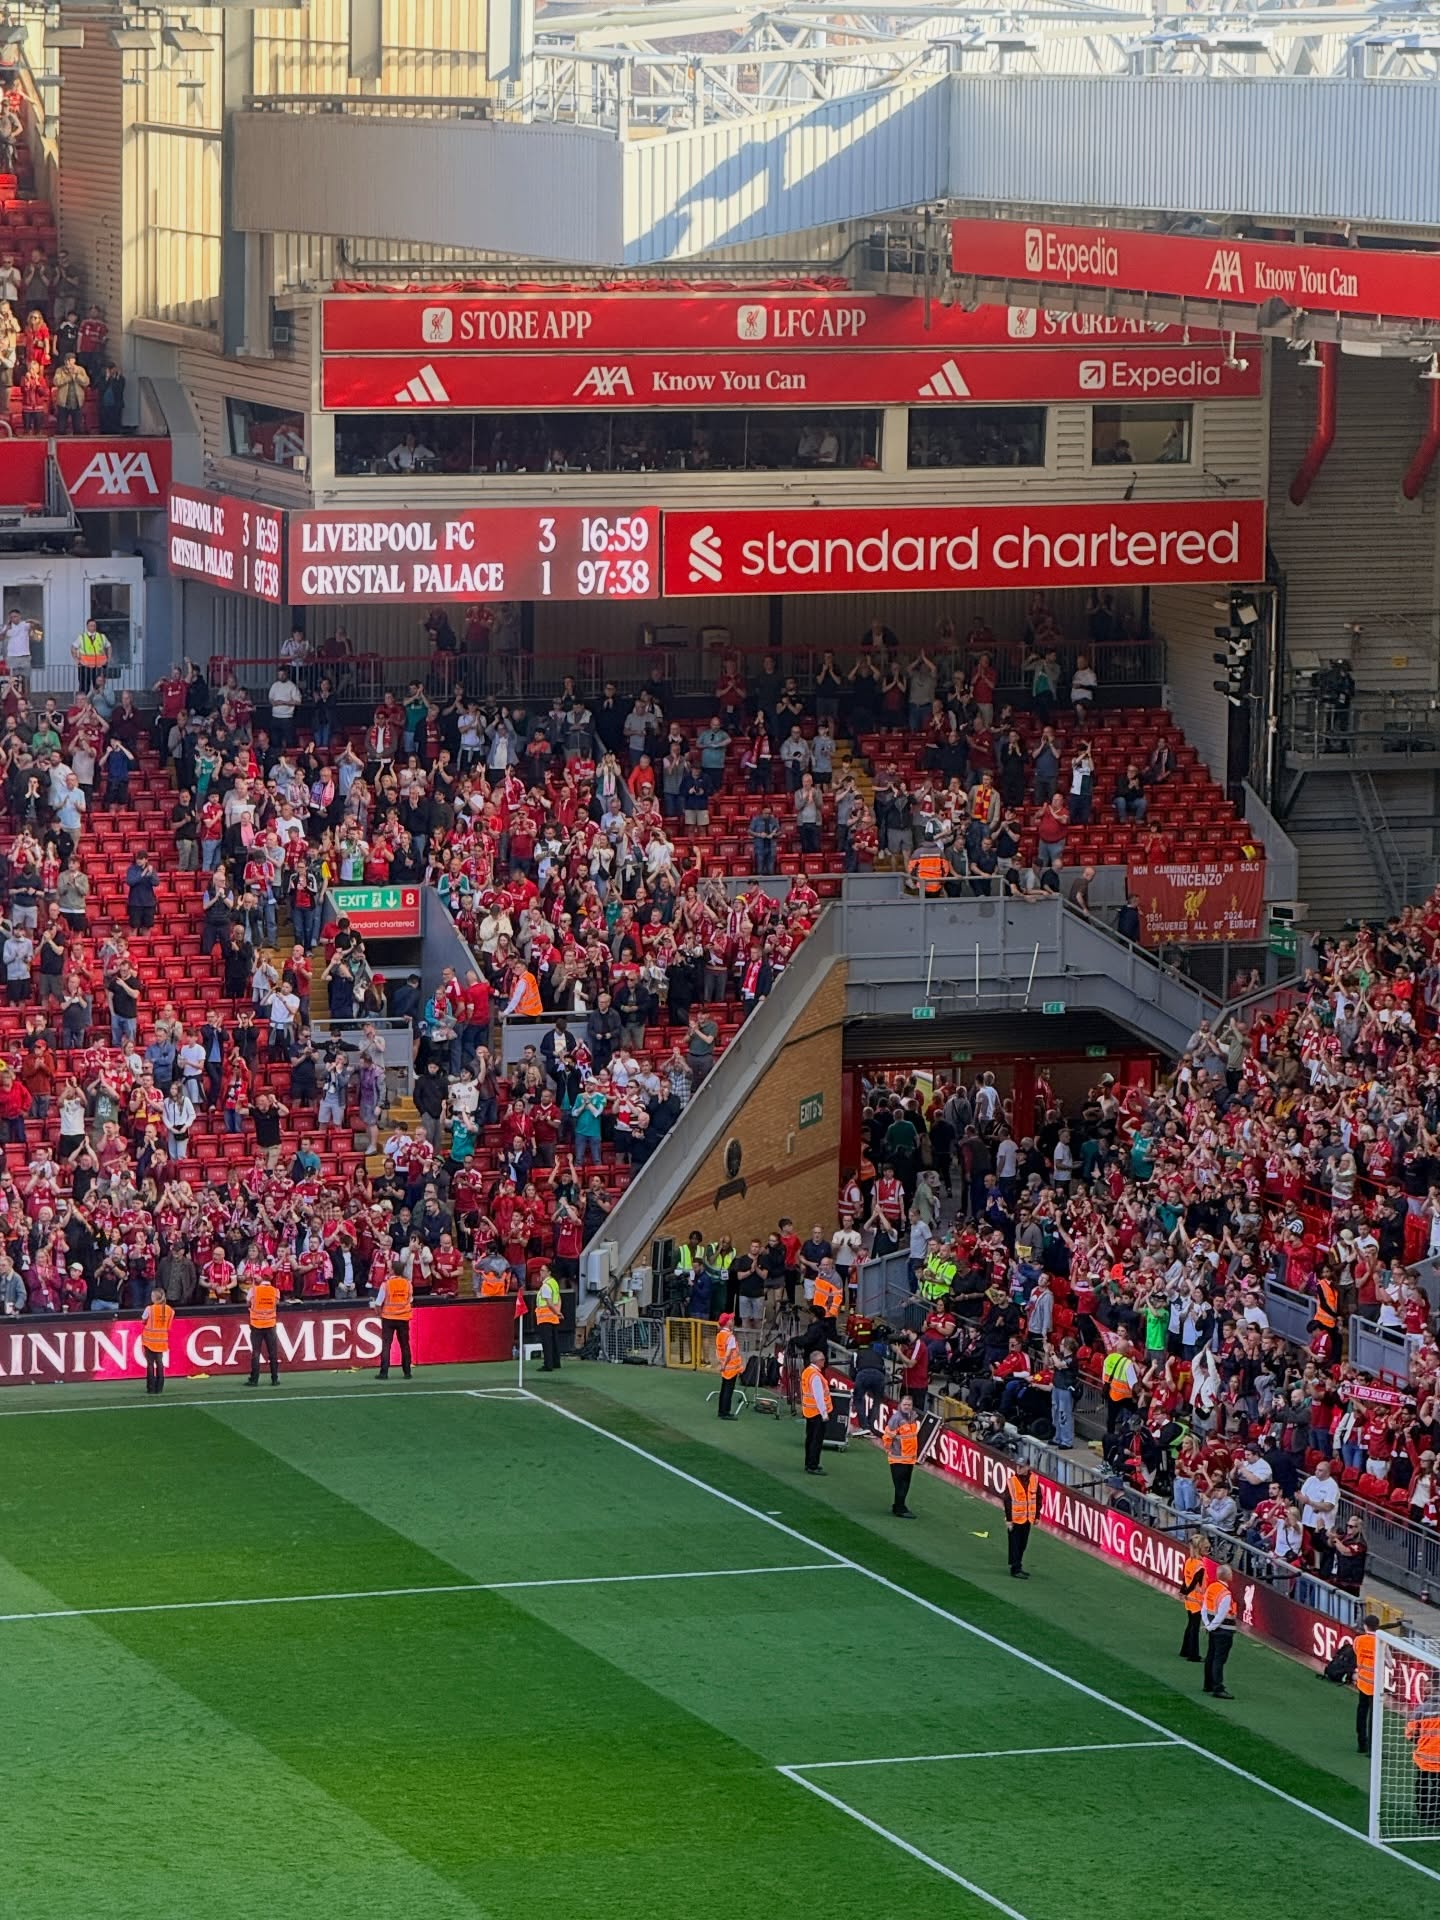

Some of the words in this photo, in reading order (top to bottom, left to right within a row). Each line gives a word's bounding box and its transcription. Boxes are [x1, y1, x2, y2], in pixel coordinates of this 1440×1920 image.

[1047, 233, 1119, 280] Expedia
[1205, 249, 1245, 294] AXA
[1255, 261, 1297, 292] Know
[1299, 266, 1329, 294] You
[1330, 267, 1359, 297] Can
[459, 310, 539, 340] STORE
[542, 311, 592, 339] APP
[773, 309, 816, 337] LFC
[818, 309, 867, 337] APP
[573, 366, 635, 396] AXA
[652, 371, 715, 391] Know
[719, 370, 761, 390] You
[765, 370, 806, 390] Can
[1112, 361, 1221, 391] Expedia
[69, 452, 159, 494] AXA
[171, 497, 213, 533] LIVERPOOL
[214, 506, 224, 535] FC
[242, 512, 249, 547] 3
[255, 515, 279, 554] 16:59
[302, 522, 437, 552] LIVERPOOL
[444, 521, 475, 550] FC
[538, 518, 556, 552] 3
[581, 517, 650, 552] 16:59
[741, 525, 979, 576] standard
[992, 520, 1239, 568] chartered
[171, 536, 204, 570] CRYSTAL
[204, 545, 233, 579] PALACE
[243, 555, 249, 588] 1
[254, 558, 279, 597] 97:38
[301, 564, 405, 594] CRYSTAL
[413, 563, 504, 593] PALACE
[541, 560, 551, 595] 1
[577, 560, 650, 594] 97:38
[1133, 865, 1148, 876] NON
[1154, 865, 1199, 875] CAMMINERAI
[1204, 864, 1218, 873] MAI
[1224, 863, 1234, 872] DA
[338, 895, 368, 907] EXIT
[405, 892, 415, 906] 8
[380, 920, 415, 928] chartered
[1147, 920, 1188, 931] CONQUERED
[1194, 919, 1208, 929] ALL
[1214, 920, 1224, 929] OF
[0, 1330, 170, 1377] INING
[186, 1317, 384, 1367] GAMES
[939, 1434, 980, 1481] SEAT
[1039, 1482, 1125, 1555] MAINING
[1129, 1531, 1186, 1585] GAME
